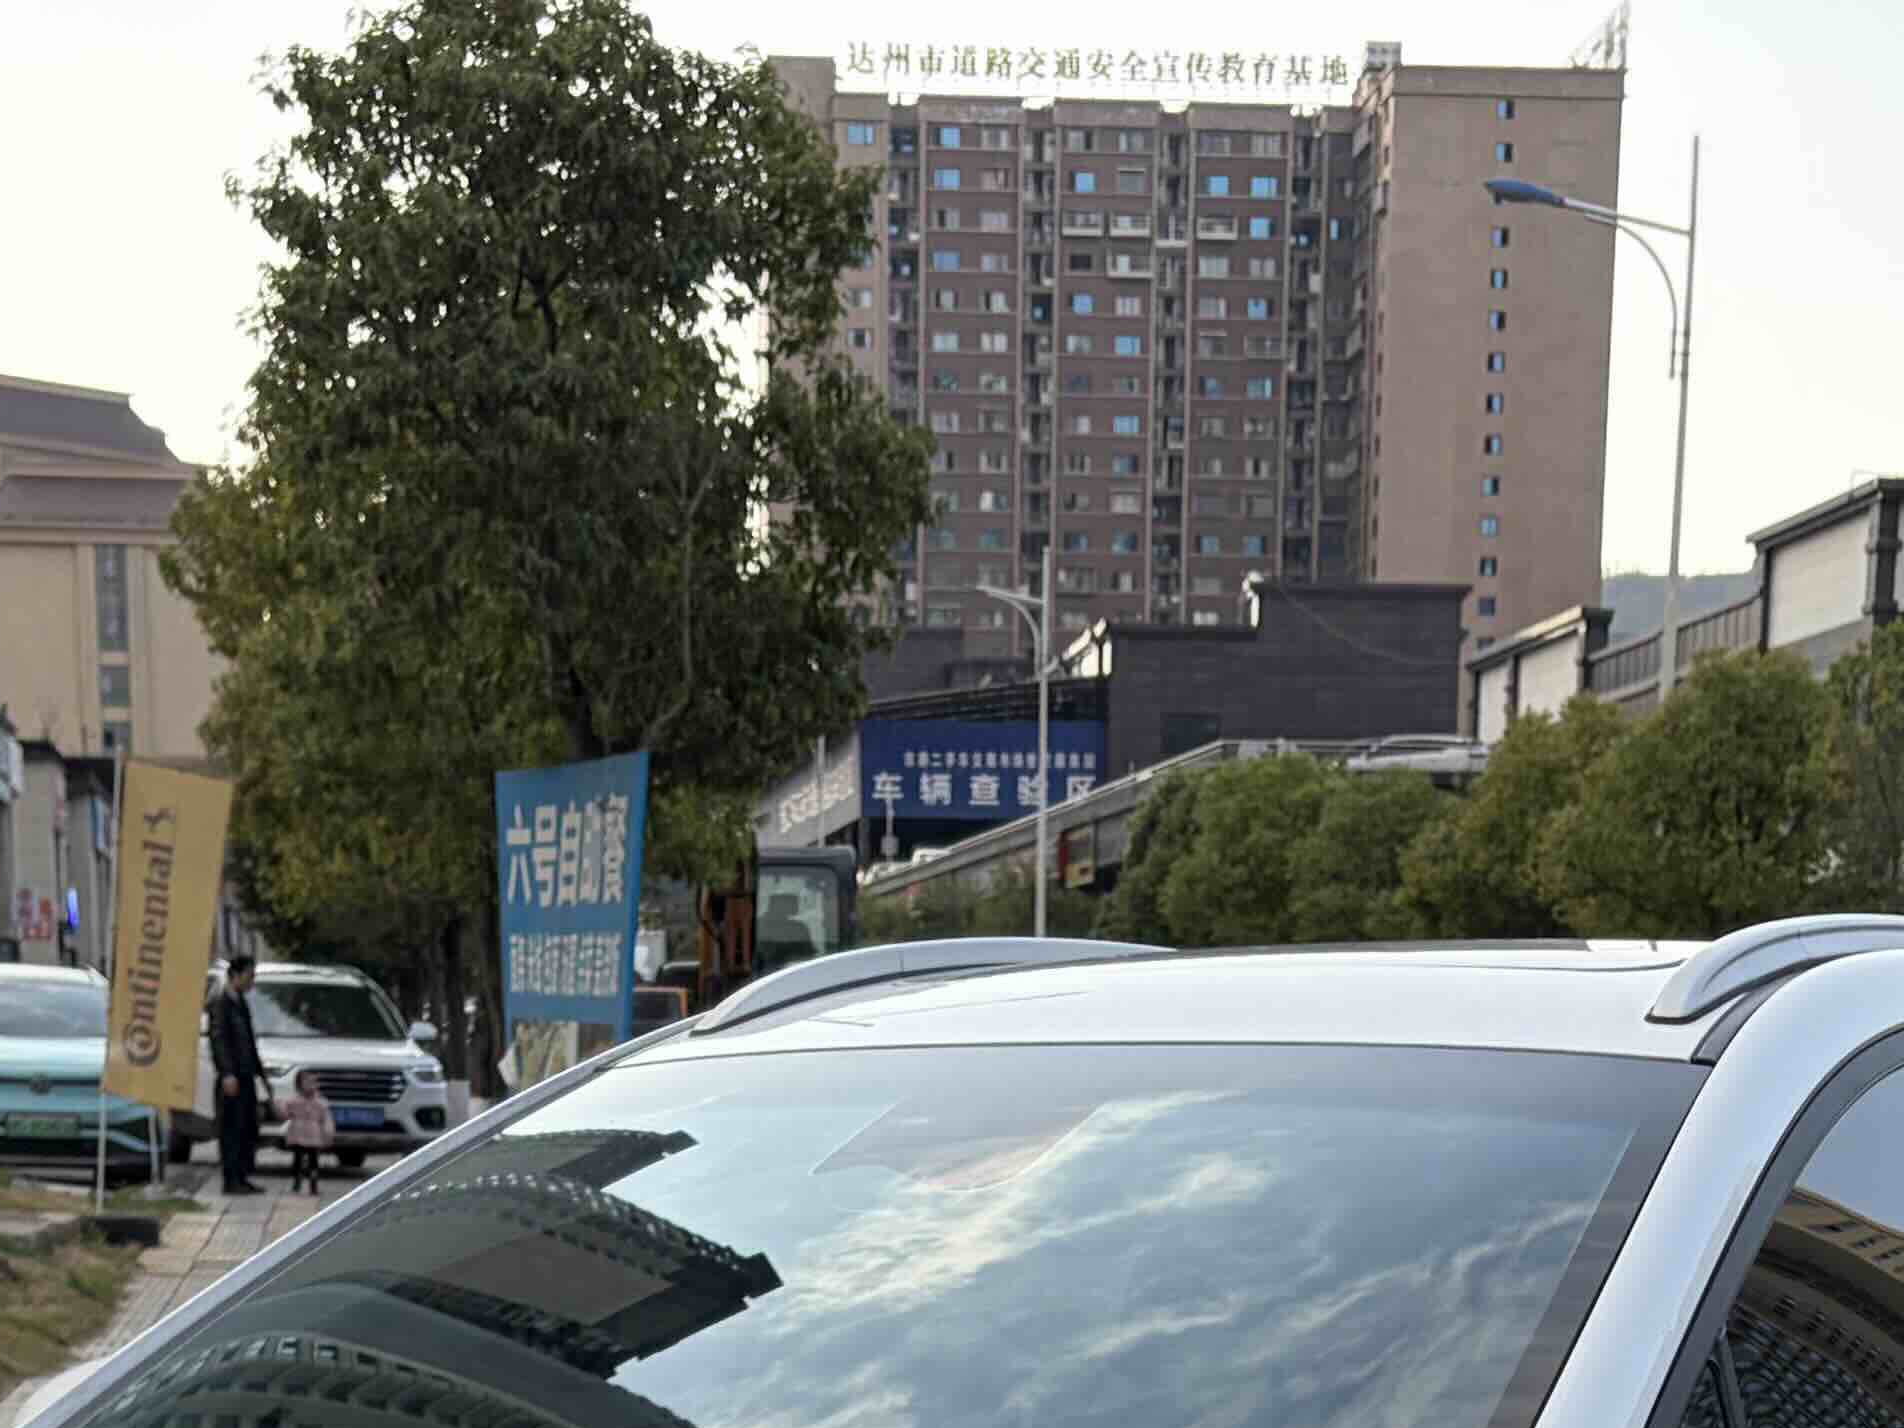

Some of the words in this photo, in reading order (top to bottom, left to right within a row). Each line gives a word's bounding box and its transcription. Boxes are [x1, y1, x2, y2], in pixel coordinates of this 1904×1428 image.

[847, 41, 1349, 86] 达州市道路交通安全宣传教育基地
[872, 771, 1097, 807] 车辆查验区
[506, 791, 628, 908] 六号自助餐
[122, 838, 176, 1068] Continental
